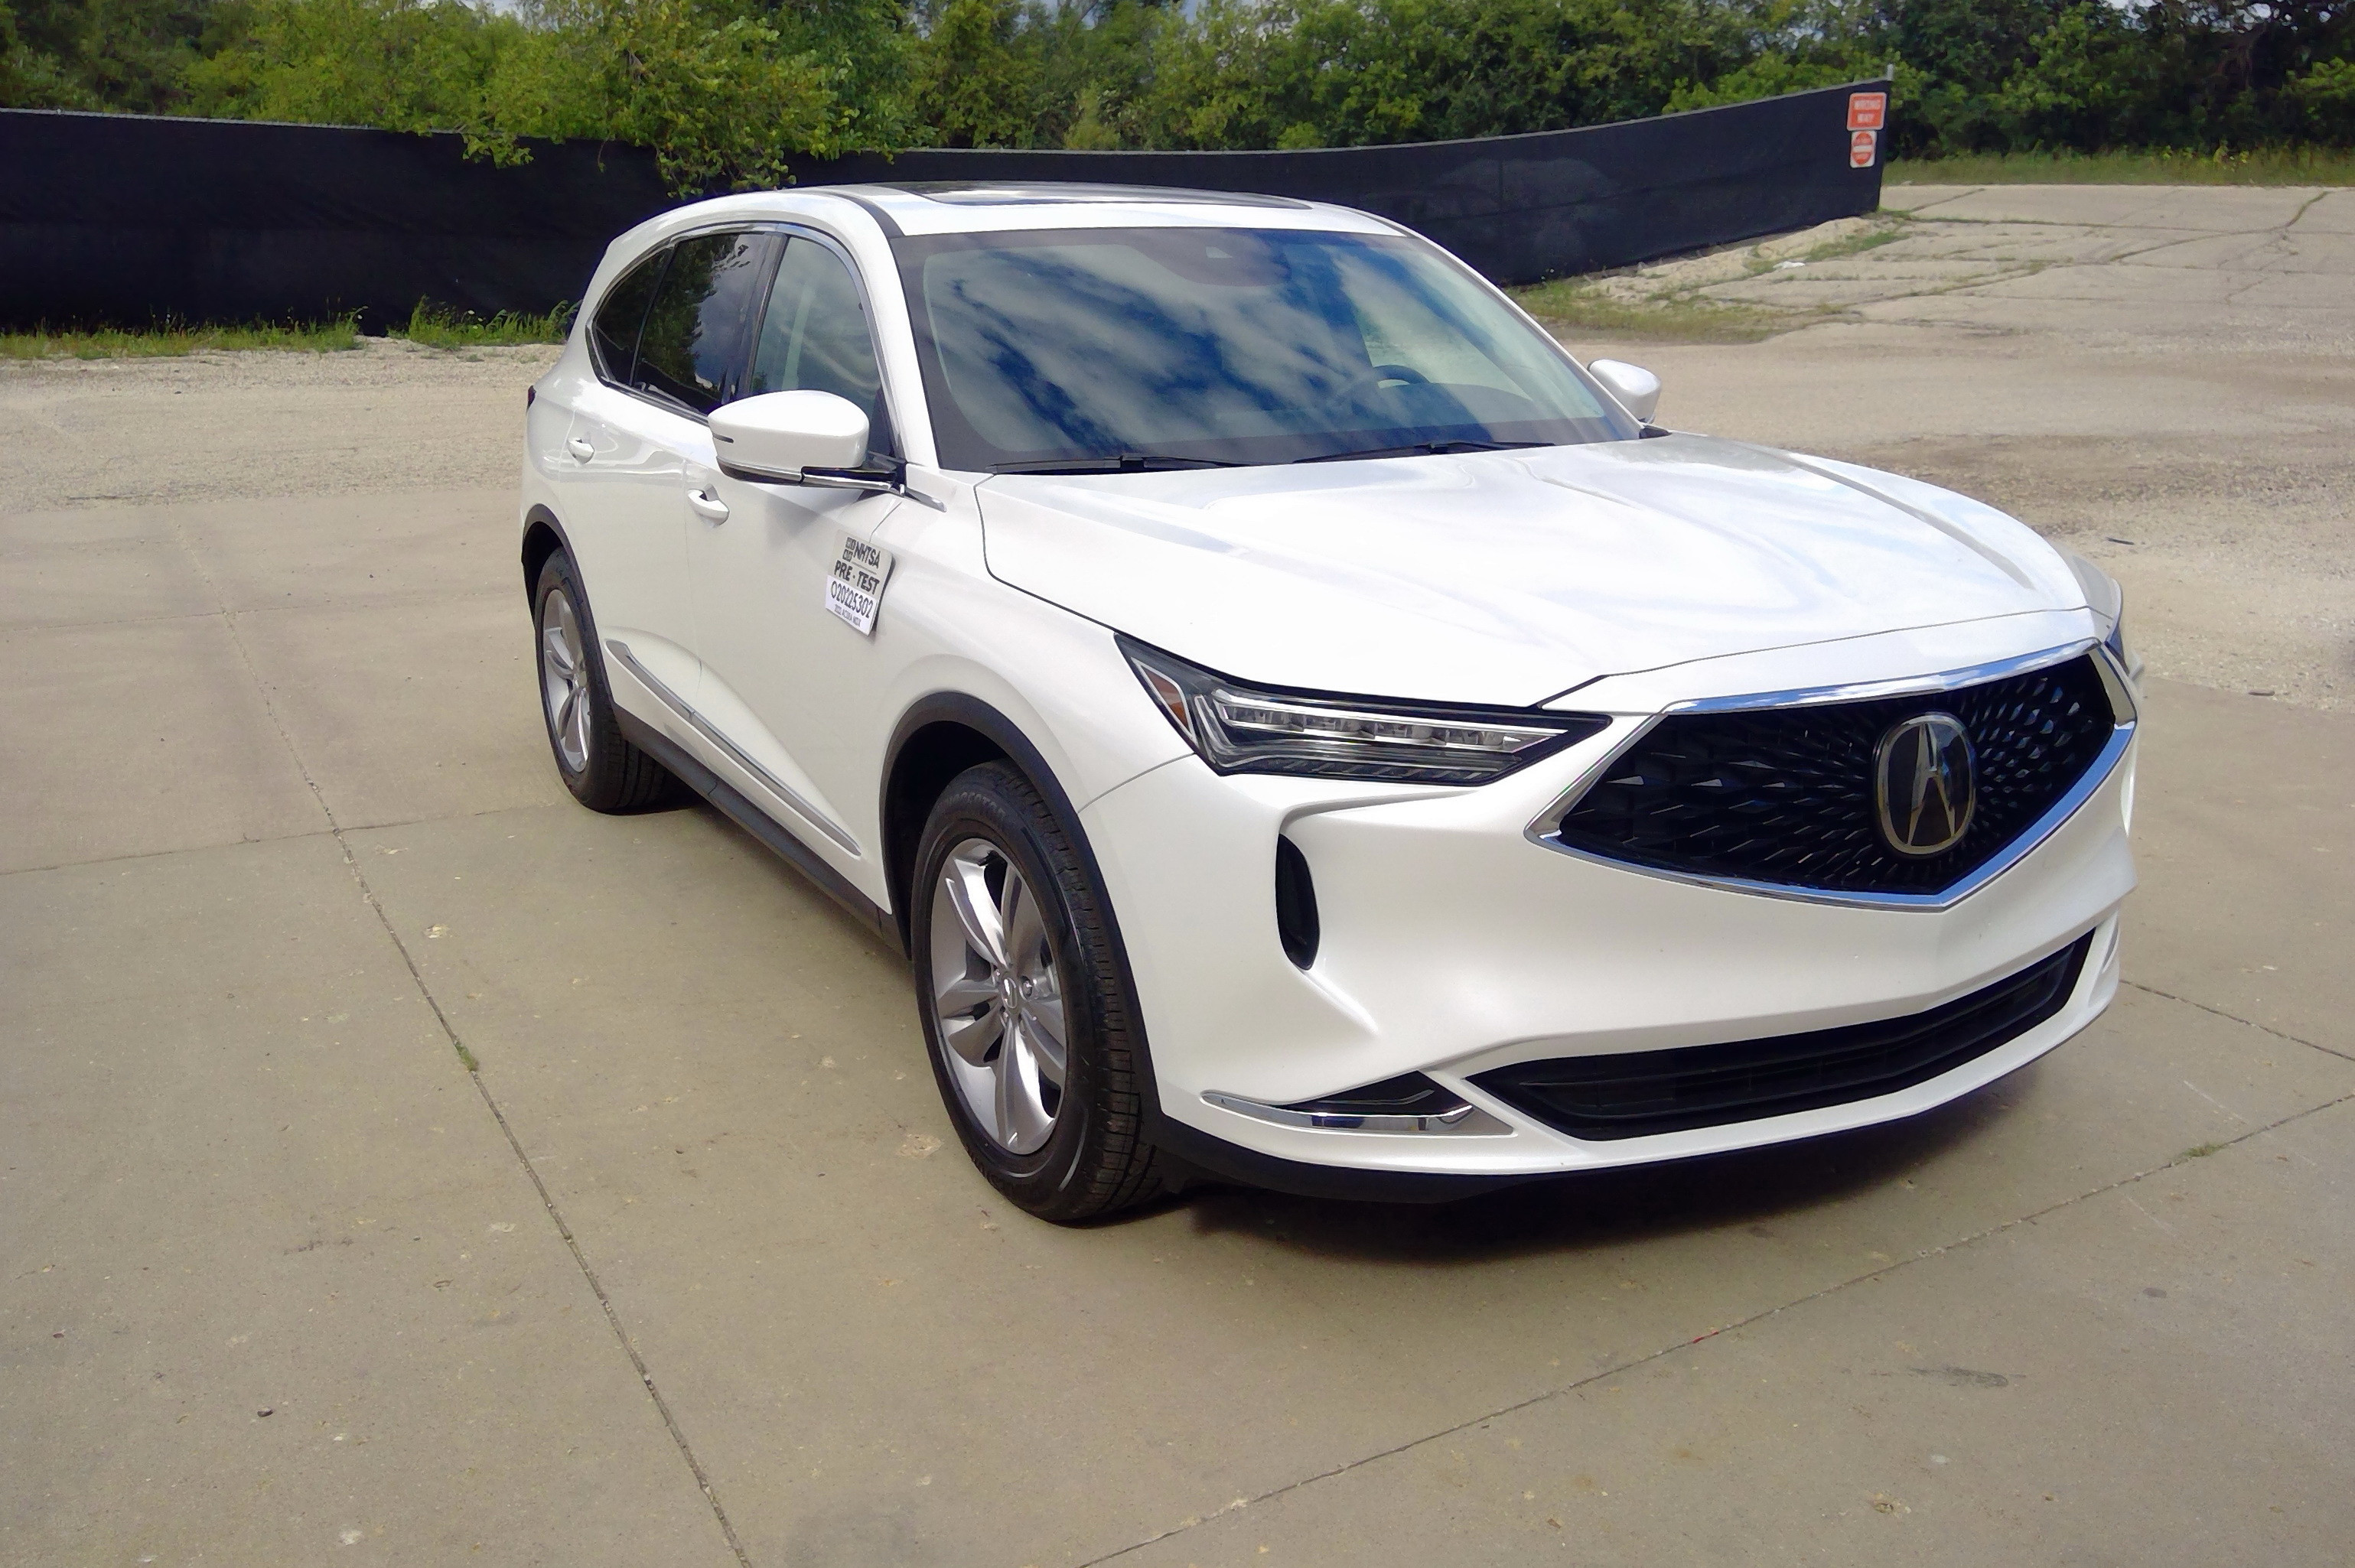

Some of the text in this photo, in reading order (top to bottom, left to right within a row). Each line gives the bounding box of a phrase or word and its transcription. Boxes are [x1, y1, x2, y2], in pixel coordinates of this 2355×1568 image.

[854, 542, 881, 569] NHTSA
[834, 560, 853, 581] PRE
[857, 571, 880, 594] TEST
